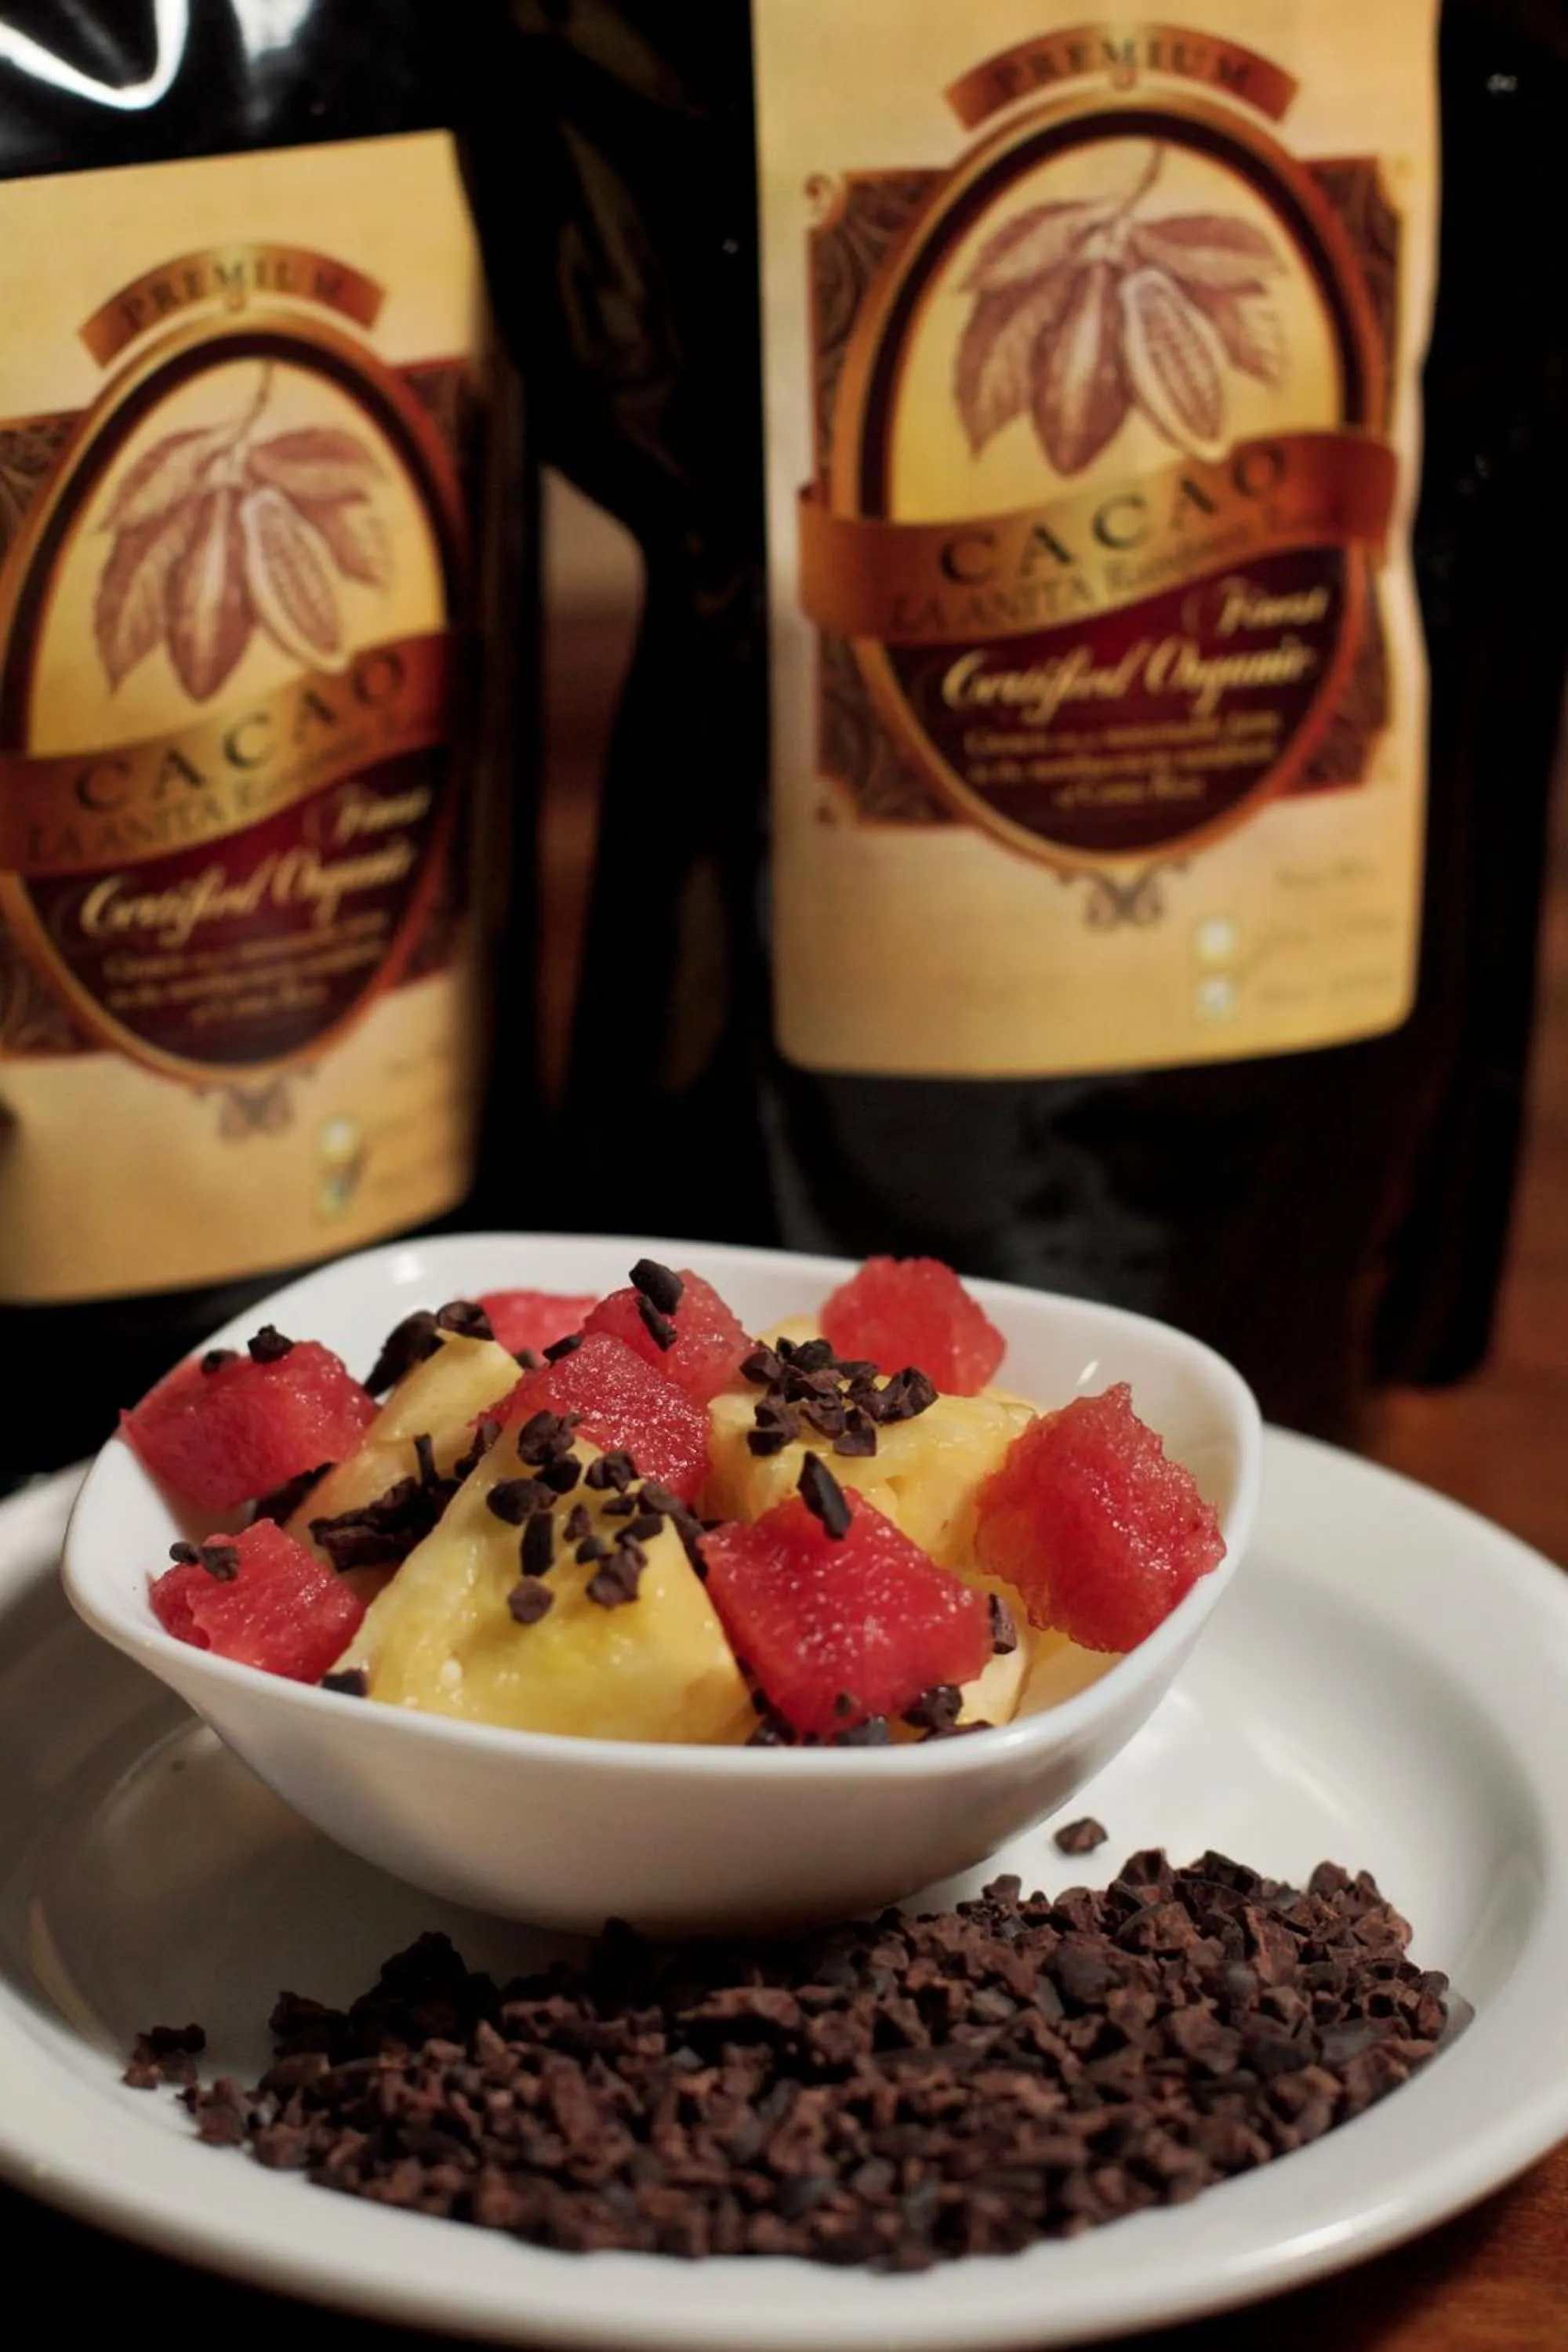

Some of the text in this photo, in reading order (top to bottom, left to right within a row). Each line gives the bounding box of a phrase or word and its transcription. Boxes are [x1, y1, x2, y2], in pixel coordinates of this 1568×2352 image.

[991, 39, 1252, 95] PREMIUM
[121, 259, 345, 332] PREMIUM
[939, 447, 1287, 586] CACAO
[1143, 632, 1318, 725] Organic
[73, 651, 404, 813] CACAO
